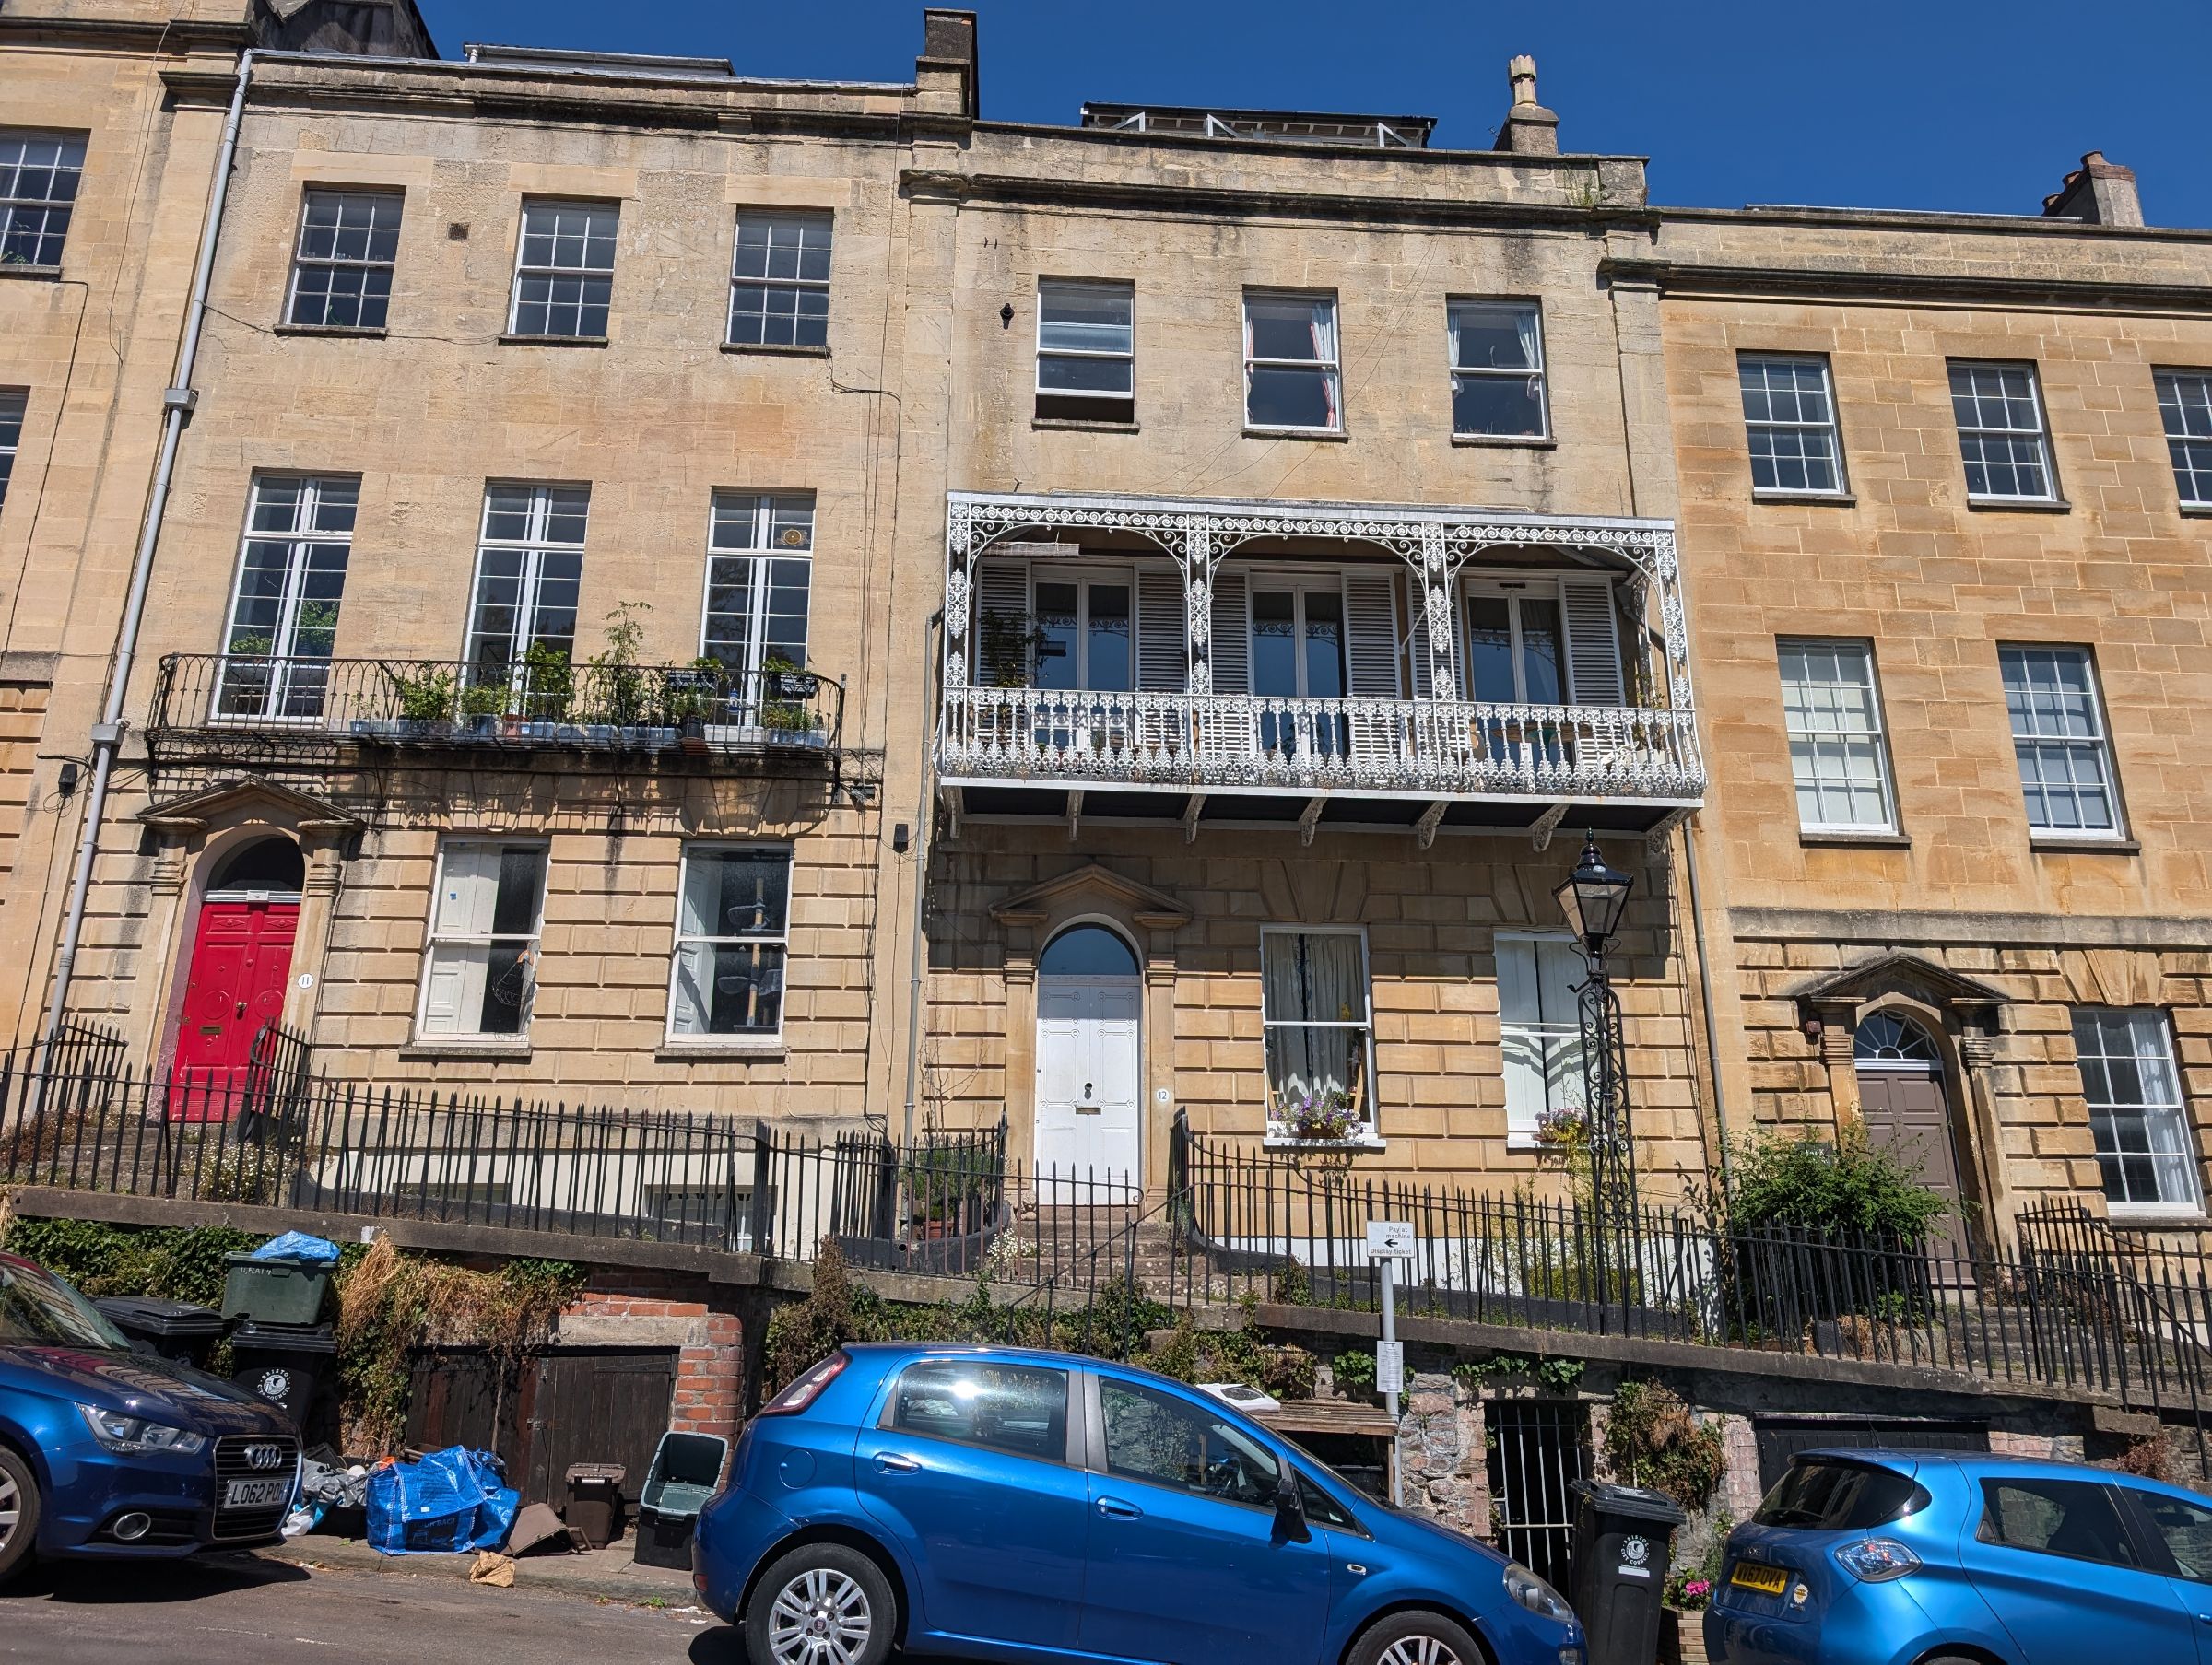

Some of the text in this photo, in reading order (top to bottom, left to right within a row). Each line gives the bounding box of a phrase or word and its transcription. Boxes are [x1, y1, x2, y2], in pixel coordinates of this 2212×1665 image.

[301, 976, 310, 986] 11
[1159, 1090, 1167, 1100] 12
[261, 1368, 291, 1381] BRISTOL
[1623, 1534, 1650, 1546] BRISTOL
